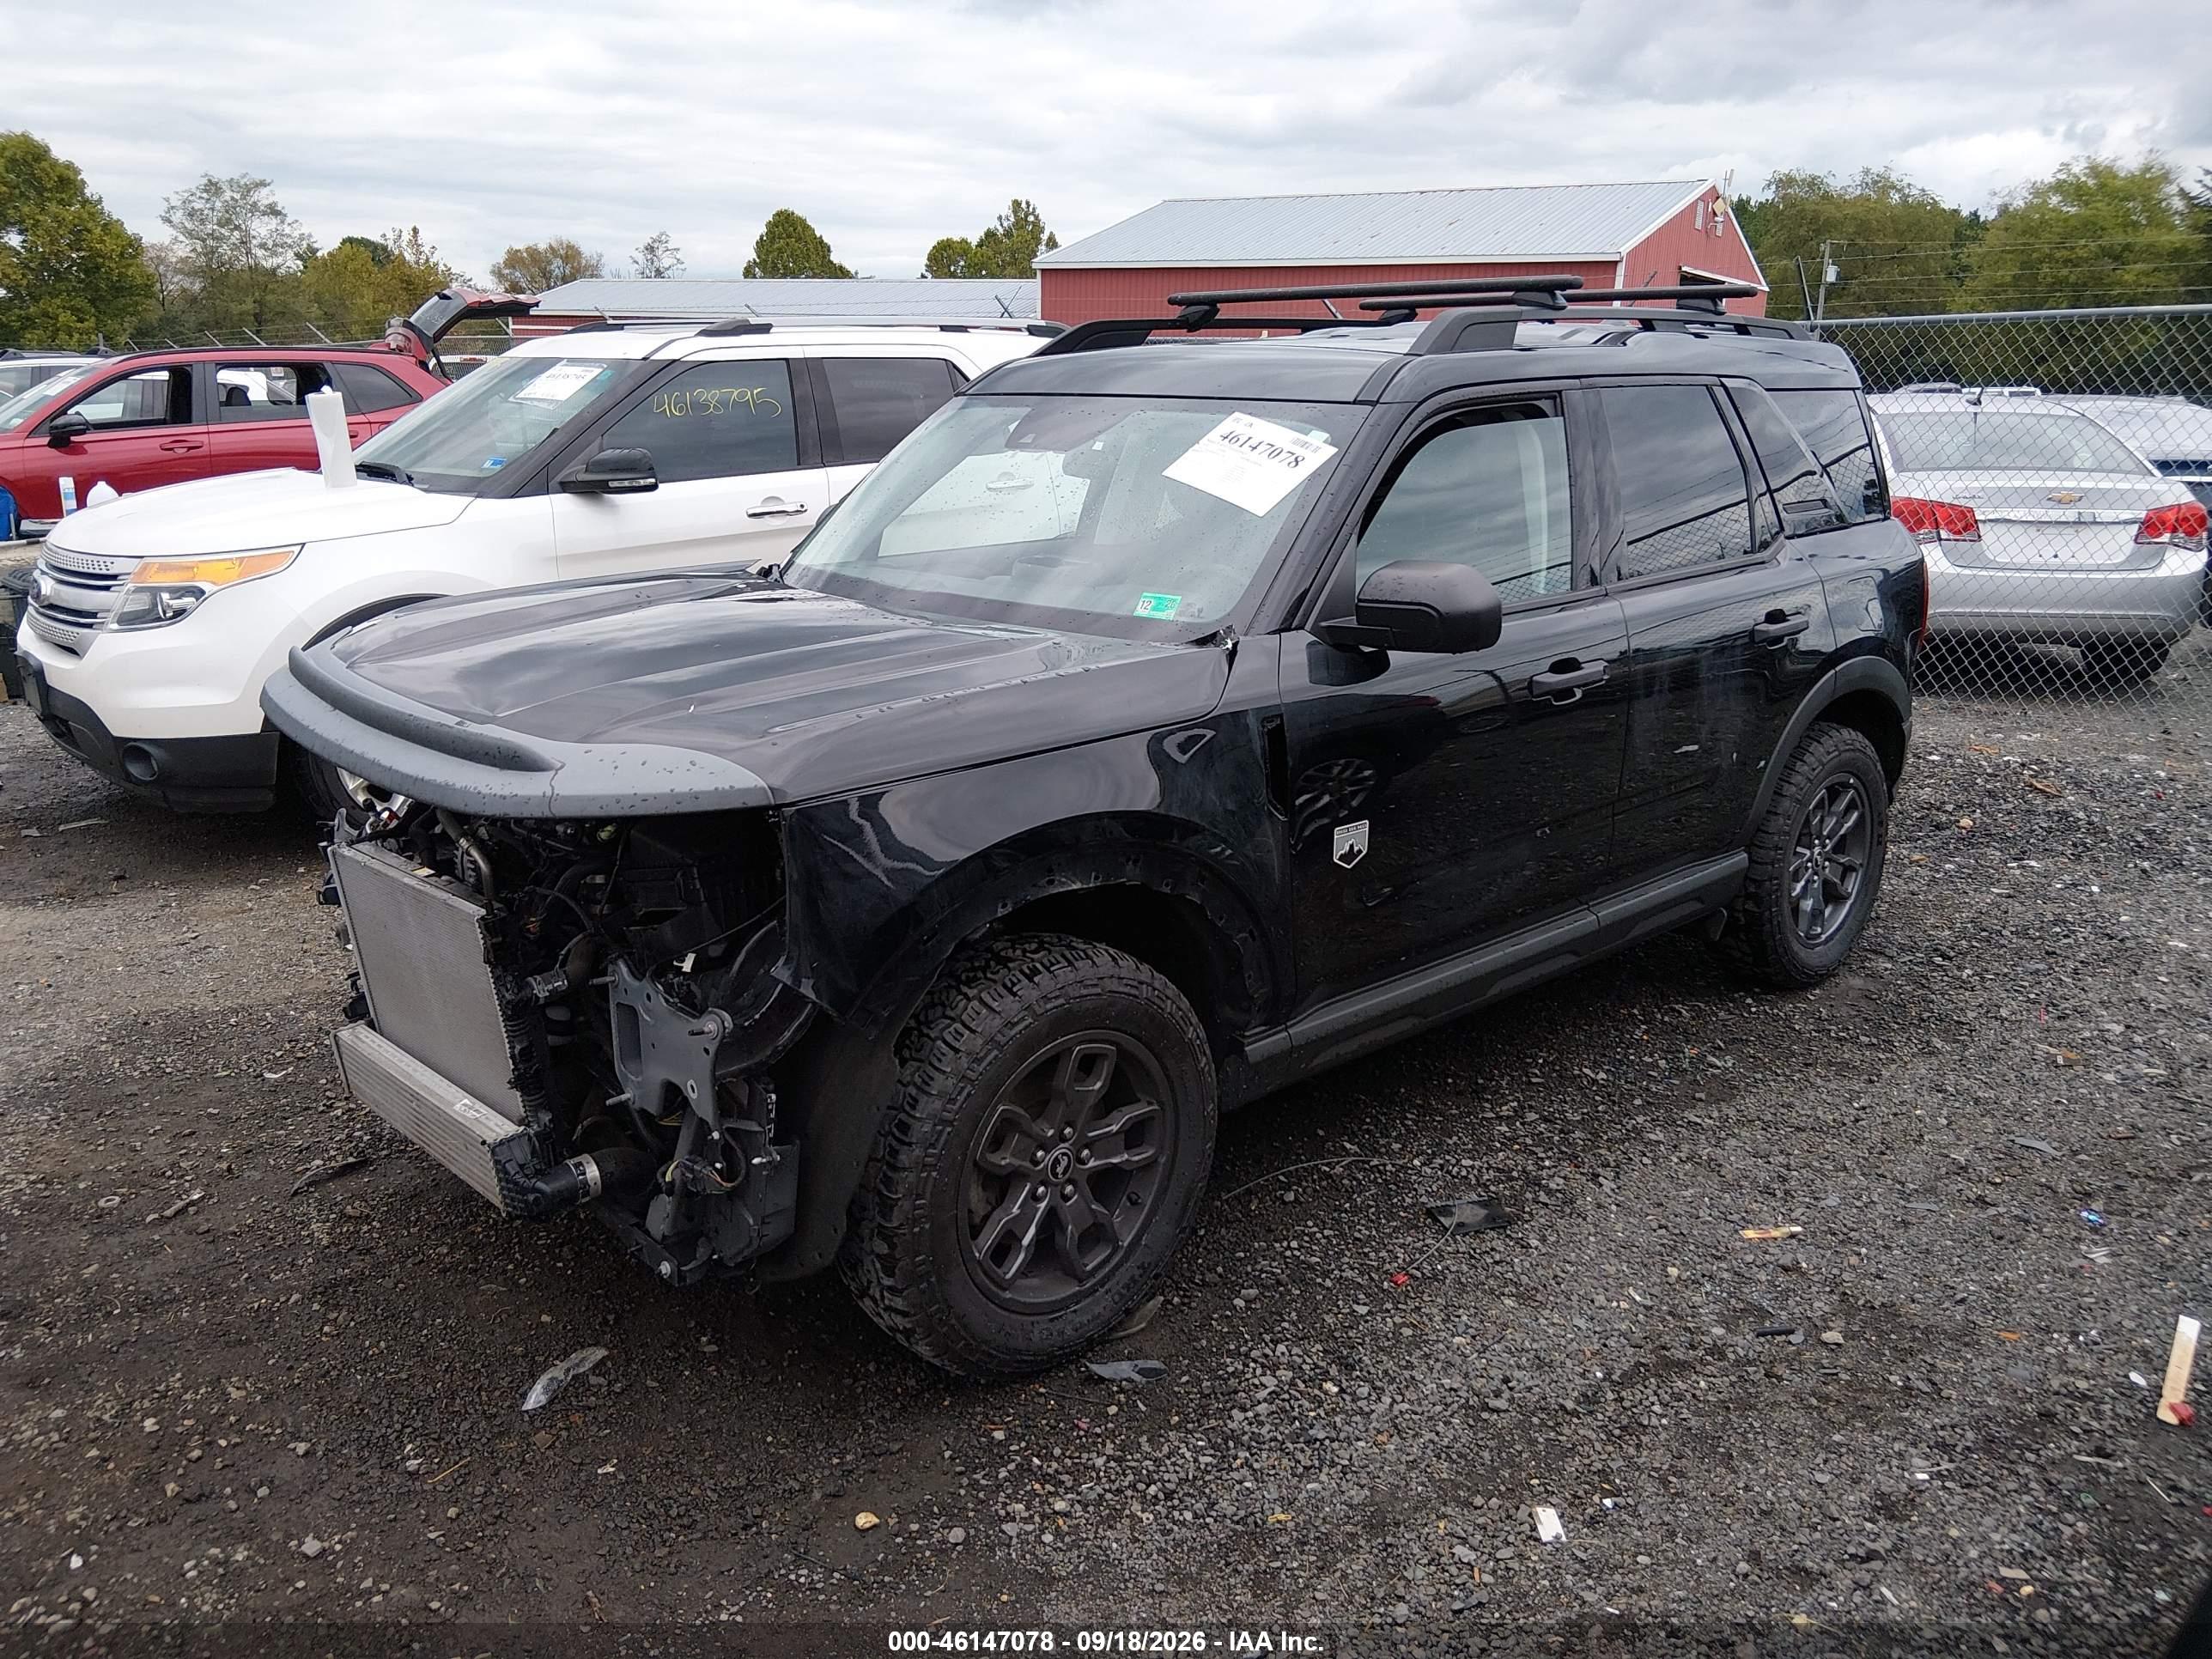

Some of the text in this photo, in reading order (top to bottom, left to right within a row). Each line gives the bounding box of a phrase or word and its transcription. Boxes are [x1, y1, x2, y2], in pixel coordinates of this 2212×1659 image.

[653, 388, 781, 418] 46138795
[1219, 430, 1305, 469] 46147078
[1139, 599, 1152, 611] 12
